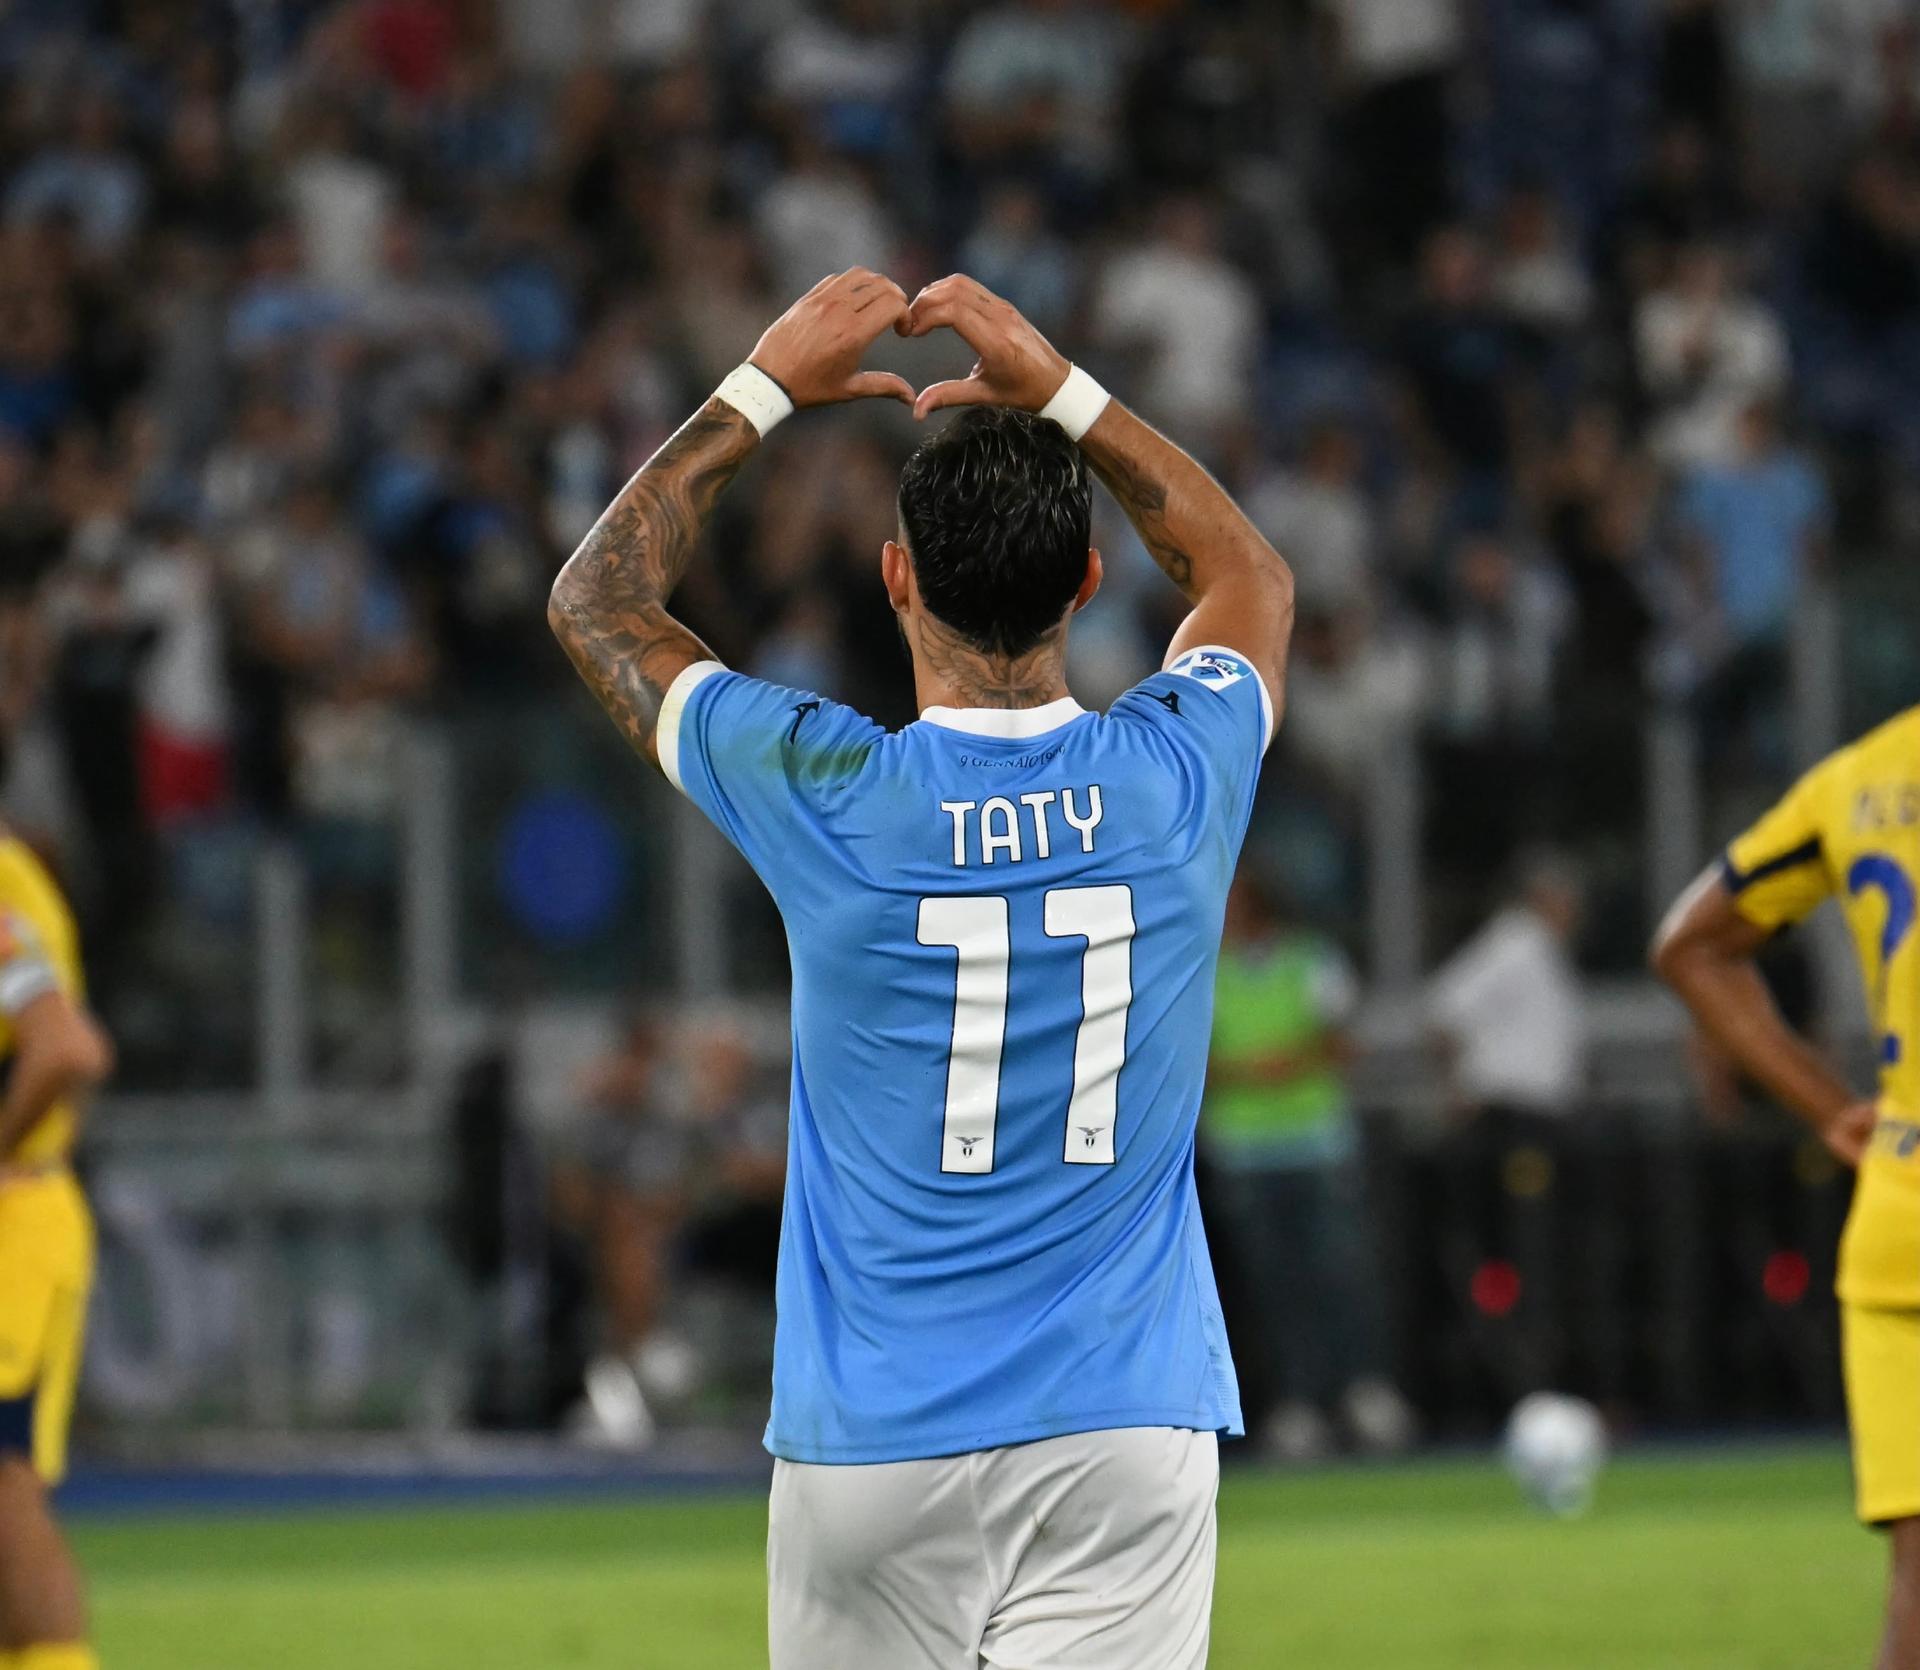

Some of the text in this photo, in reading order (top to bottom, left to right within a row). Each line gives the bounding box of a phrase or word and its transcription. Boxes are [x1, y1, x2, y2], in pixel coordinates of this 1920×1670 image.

[960, 755, 968, 768] 9
[940, 784, 1104, 866] TATY
[916, 884, 1137, 1174] 11
